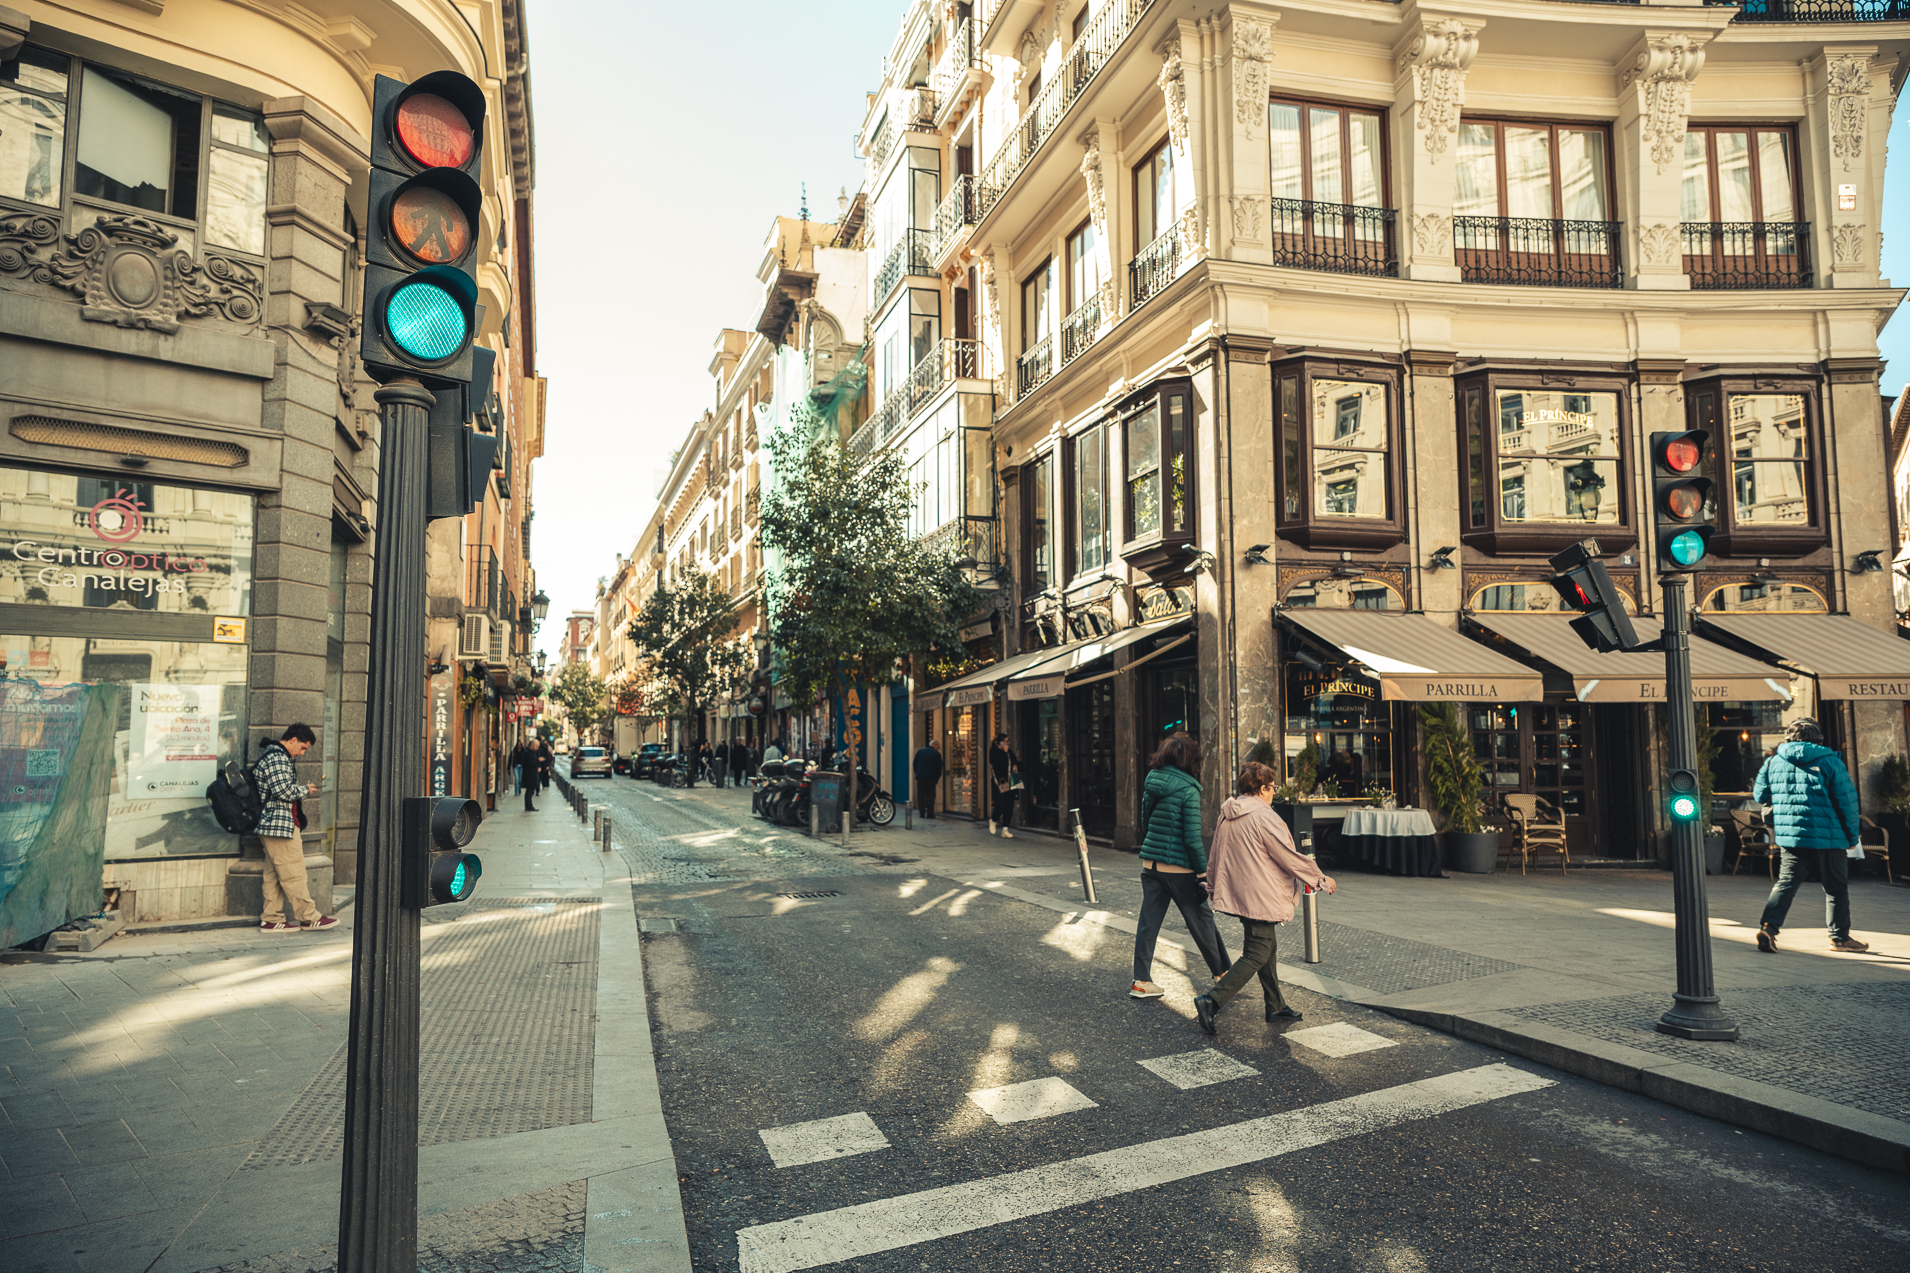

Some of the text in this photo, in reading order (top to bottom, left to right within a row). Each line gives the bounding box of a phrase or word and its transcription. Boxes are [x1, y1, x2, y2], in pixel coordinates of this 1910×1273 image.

[1522, 407, 1594, 427] EL PRÍNCIPE
[37, 567, 185, 598] Canalejas
[1023, 683, 1049, 696] PARRILLA
[1304, 679, 1375, 697] EL PRÍNCIPE
[1426, 683, 1498, 697] PARRILLA
[1663, 683, 1728, 697] NCIPE
[141, 690, 183, 701] Nueva
[140, 702, 202, 714] ubicación:
[156, 725, 210, 734] Santa Ana, 4
[434, 698, 448, 761] PARRILLA
[181, 734, 211, 743] minutos)
[109, 801, 155, 817] artier
